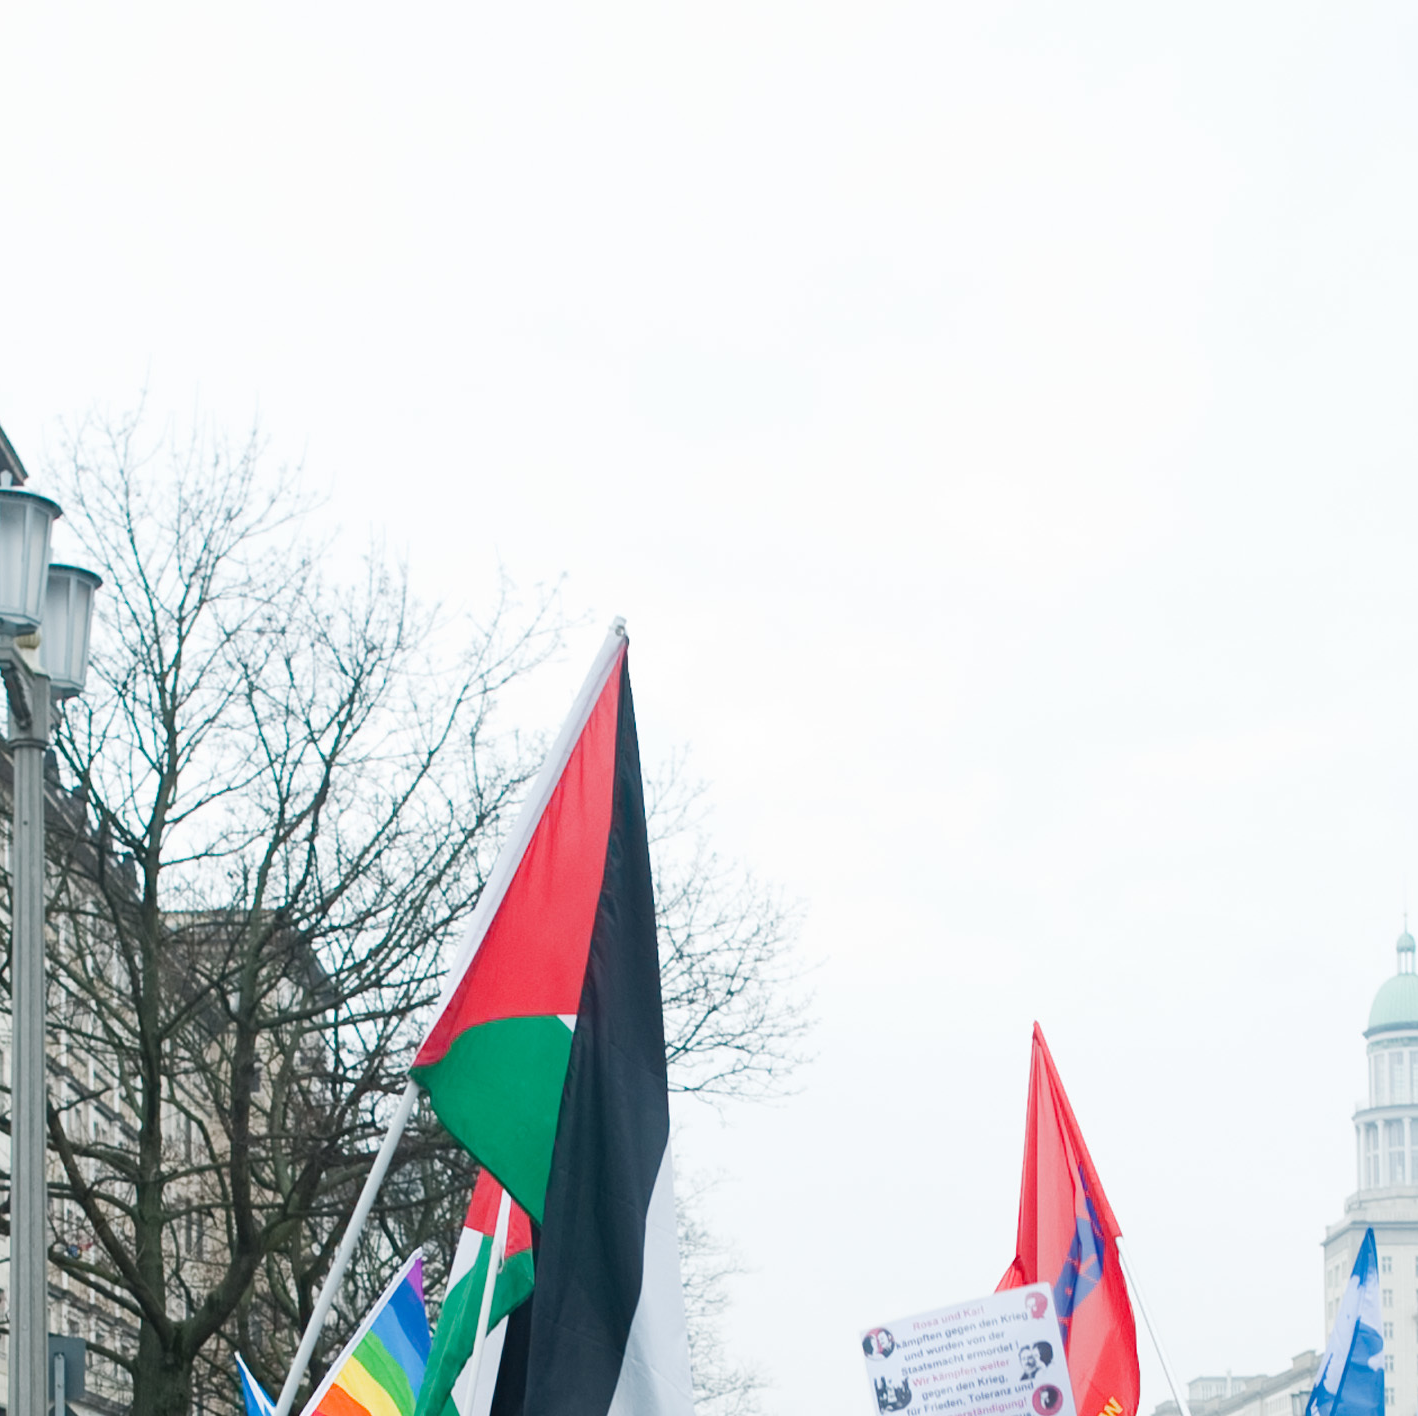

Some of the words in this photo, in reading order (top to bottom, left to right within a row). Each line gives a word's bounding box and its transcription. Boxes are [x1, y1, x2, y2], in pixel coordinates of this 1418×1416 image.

[896, 1331, 943, 1350] kämpften
[945, 1323, 977, 1338] gegen
[979, 1318, 999, 1330] den
[1001, 1311, 1029, 1324] Krieg
[913, 1319, 939, 1331] Rosa
[941, 1311, 961, 1325] und
[963, 1305, 985, 1319] Karl
[901, 1353, 965, 1377] Staatsmacht
[967, 1342, 1013, 1361] ermordet
[904, 1350, 924, 1362] und
[926, 1341, 964, 1356] wurden
[968, 1335, 986, 1346] von
[988, 1331, 1006, 1342] der
[912, 1375, 930, 1388] Wir
[932, 1366, 977, 1383] kämpfen
[980, 1359, 1009, 1372] weiter
[922, 1386, 953, 1402] gegen
[956, 1379, 976, 1392] den
[969, 1388, 1012, 1404] Toleranz
[1015, 1382, 1034, 1395] und
